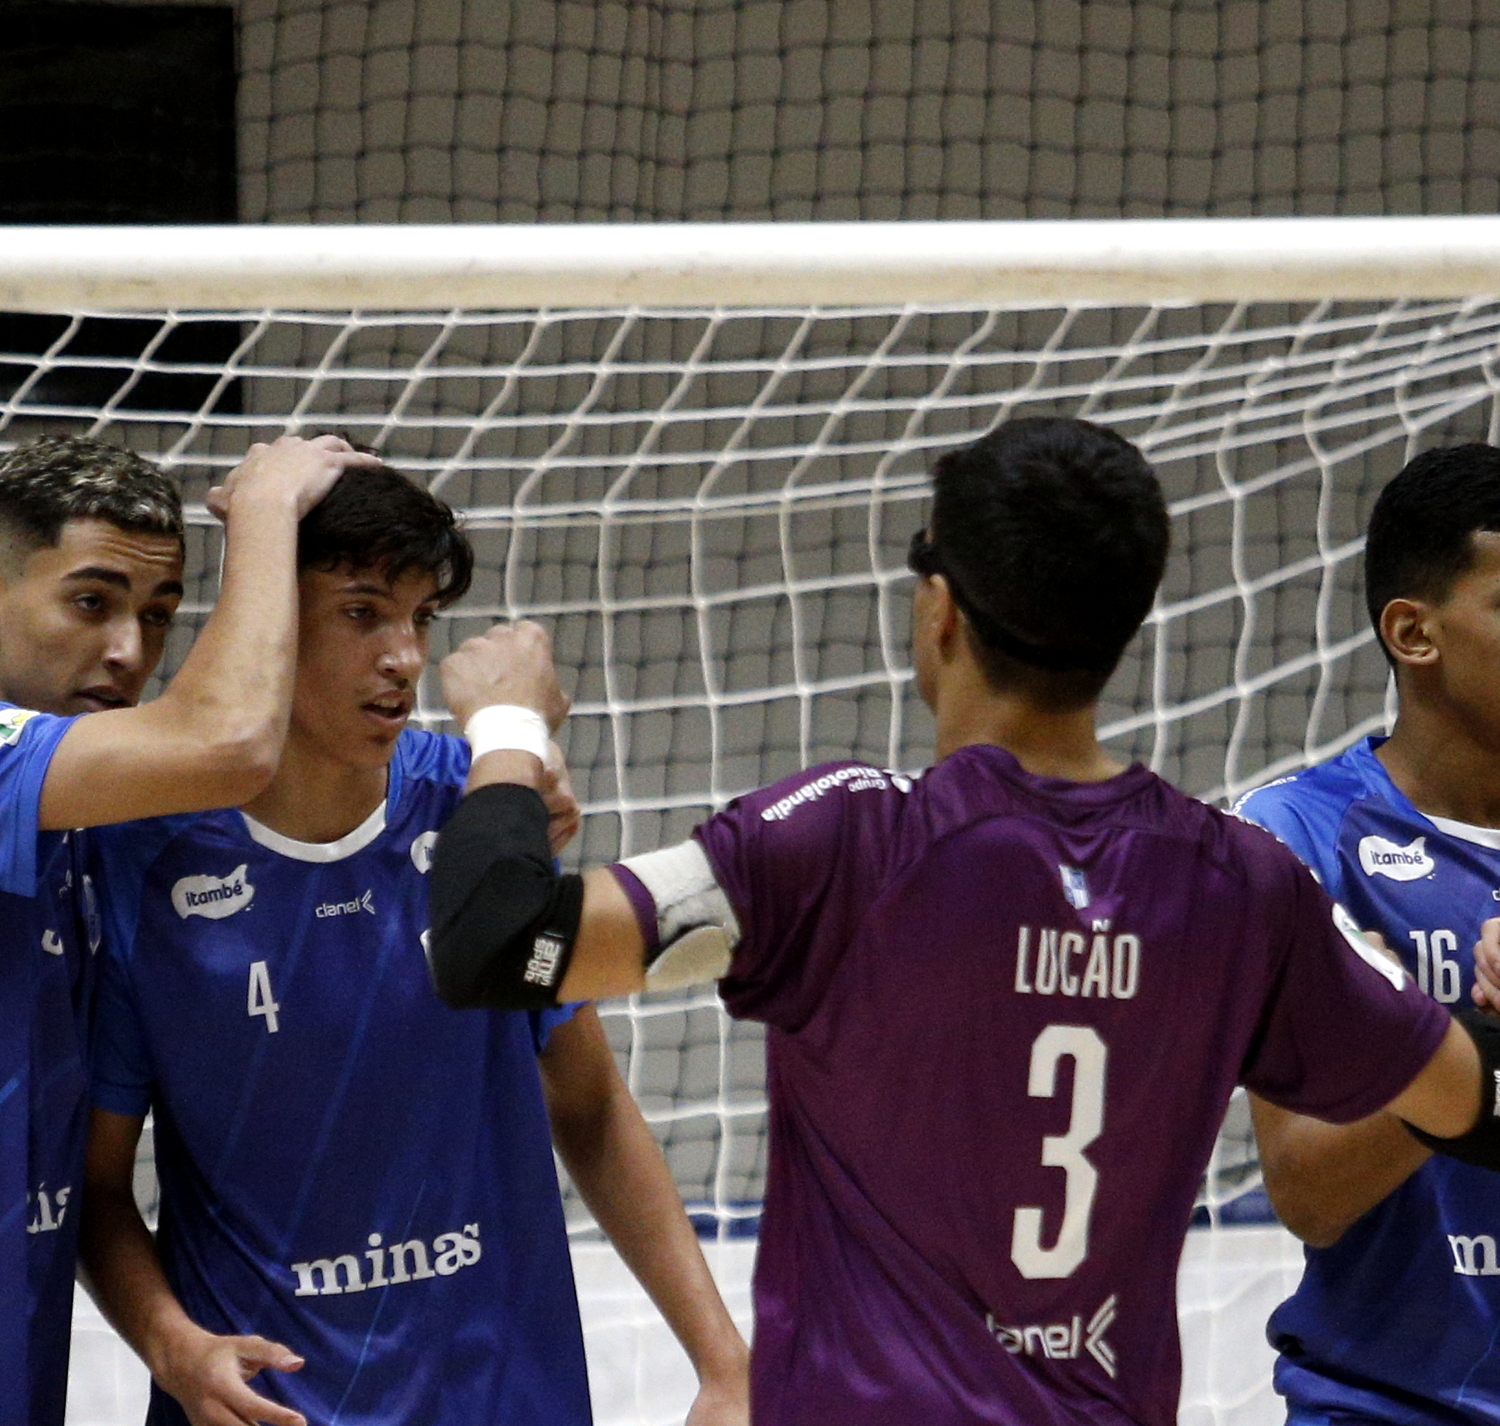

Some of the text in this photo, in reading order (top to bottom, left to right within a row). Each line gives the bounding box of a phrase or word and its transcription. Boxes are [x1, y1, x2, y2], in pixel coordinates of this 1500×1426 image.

[184, 879, 244, 908] itambé
[1370, 850, 1424, 866] itambé
[315, 897, 361, 918] clanel
[1014, 918, 1142, 1000] LUCÃO
[1409, 928, 1461, 1004] 16
[247, 960, 280, 1034] 4
[1010, 1024, 1108, 1281] 3
[290, 1222, 482, 1297] minas
